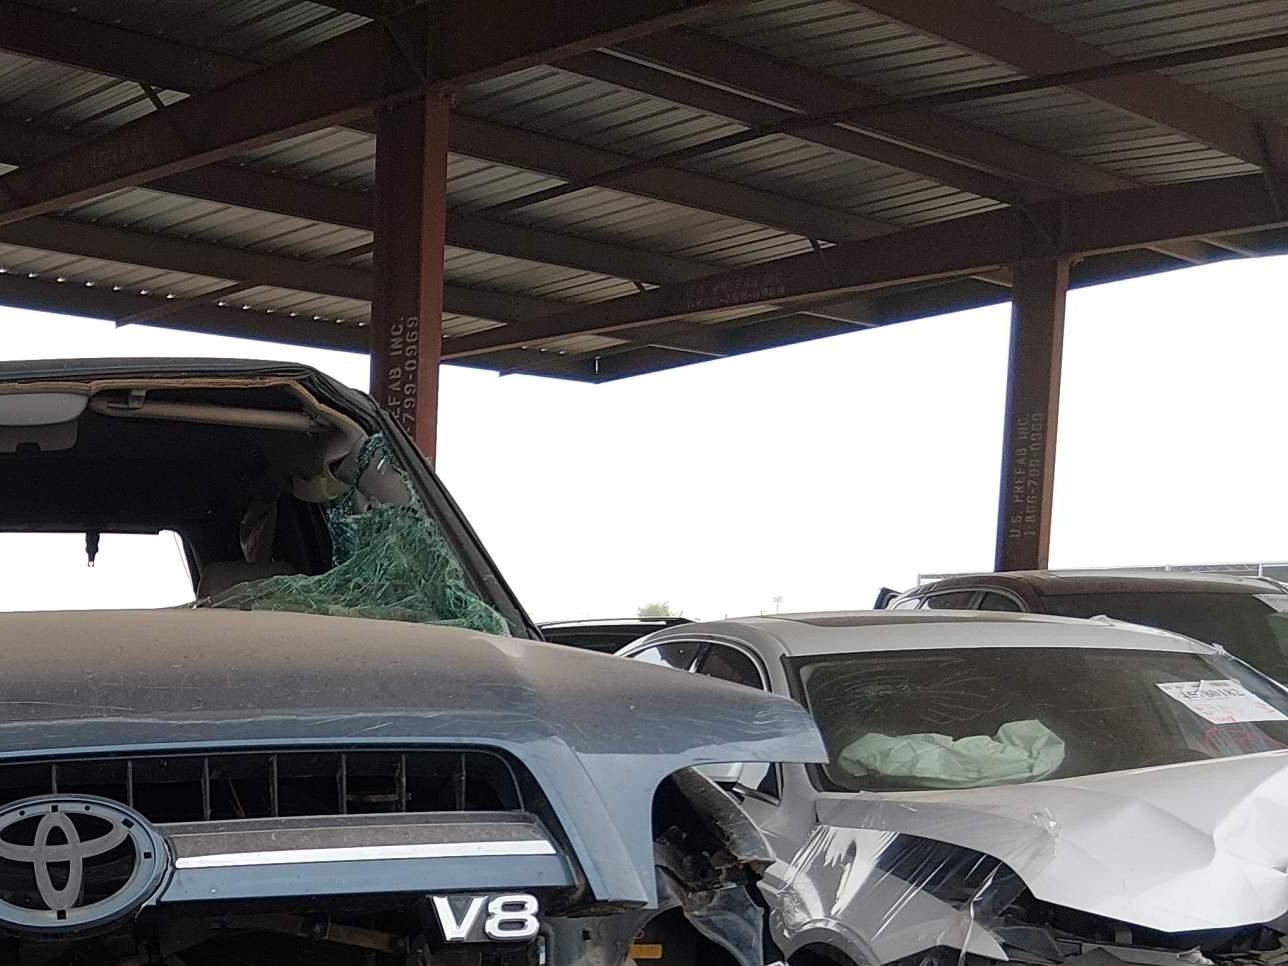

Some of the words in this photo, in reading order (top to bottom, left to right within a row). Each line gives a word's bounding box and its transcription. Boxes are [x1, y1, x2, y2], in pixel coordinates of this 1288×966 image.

[390, 316, 404, 356] INC.
[388, 367, 402, 419] EFAB
[402, 316, 419, 433] -799-0969
[1012, 448, 1027, 503] PREFAB
[429, 893, 540, 942] V8
